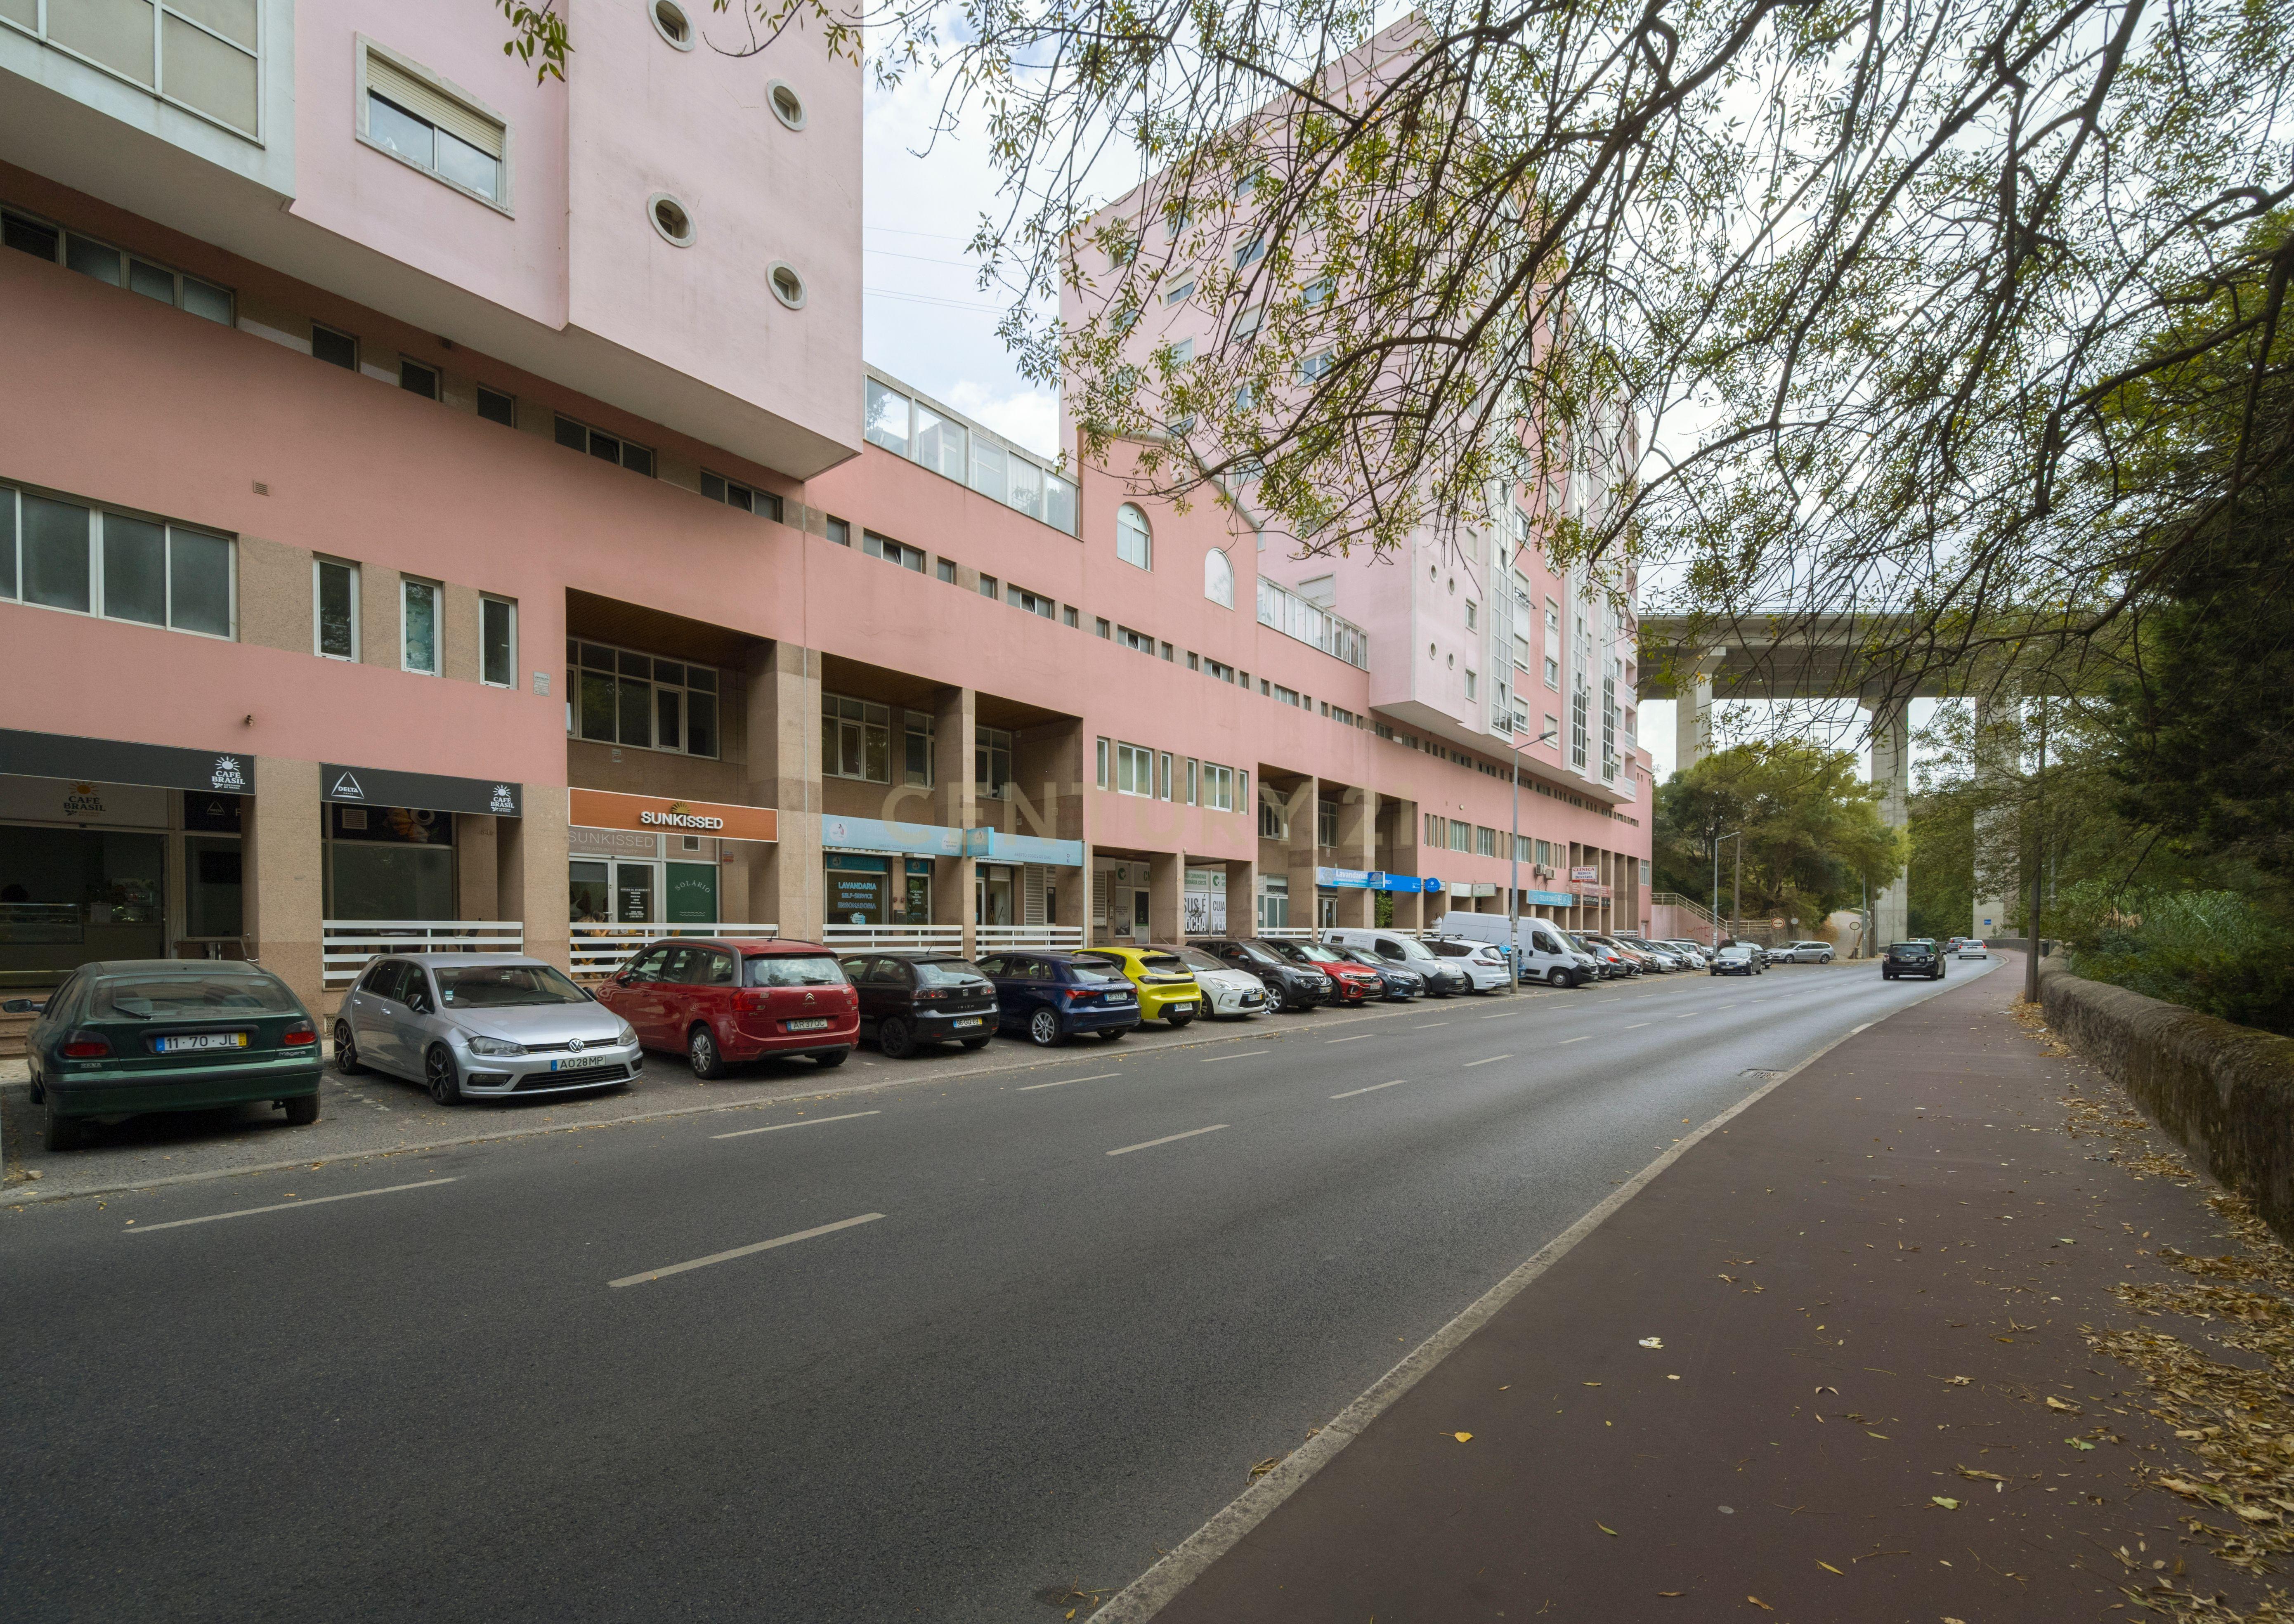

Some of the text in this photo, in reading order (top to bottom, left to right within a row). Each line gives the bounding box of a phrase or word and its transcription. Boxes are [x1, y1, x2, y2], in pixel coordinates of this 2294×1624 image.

[211, 776, 245, 784] BRASIL
[69, 795, 100, 804] CAFÉ
[63, 802, 106, 812] BRASIL
[640, 811, 723, 829] SUNKISSED
[568, 831, 654, 847] SUNKISSED
[1336, 870, 1368, 879] Lavandarias
[675, 880, 710, 893] SOLÁRIO
[838, 882, 877, 890] LAVANDARIA
[1202, 894, 1206, 914] É
[1213, 901, 1225, 911] CUJA
[1184, 917, 1206, 932] OCHA
